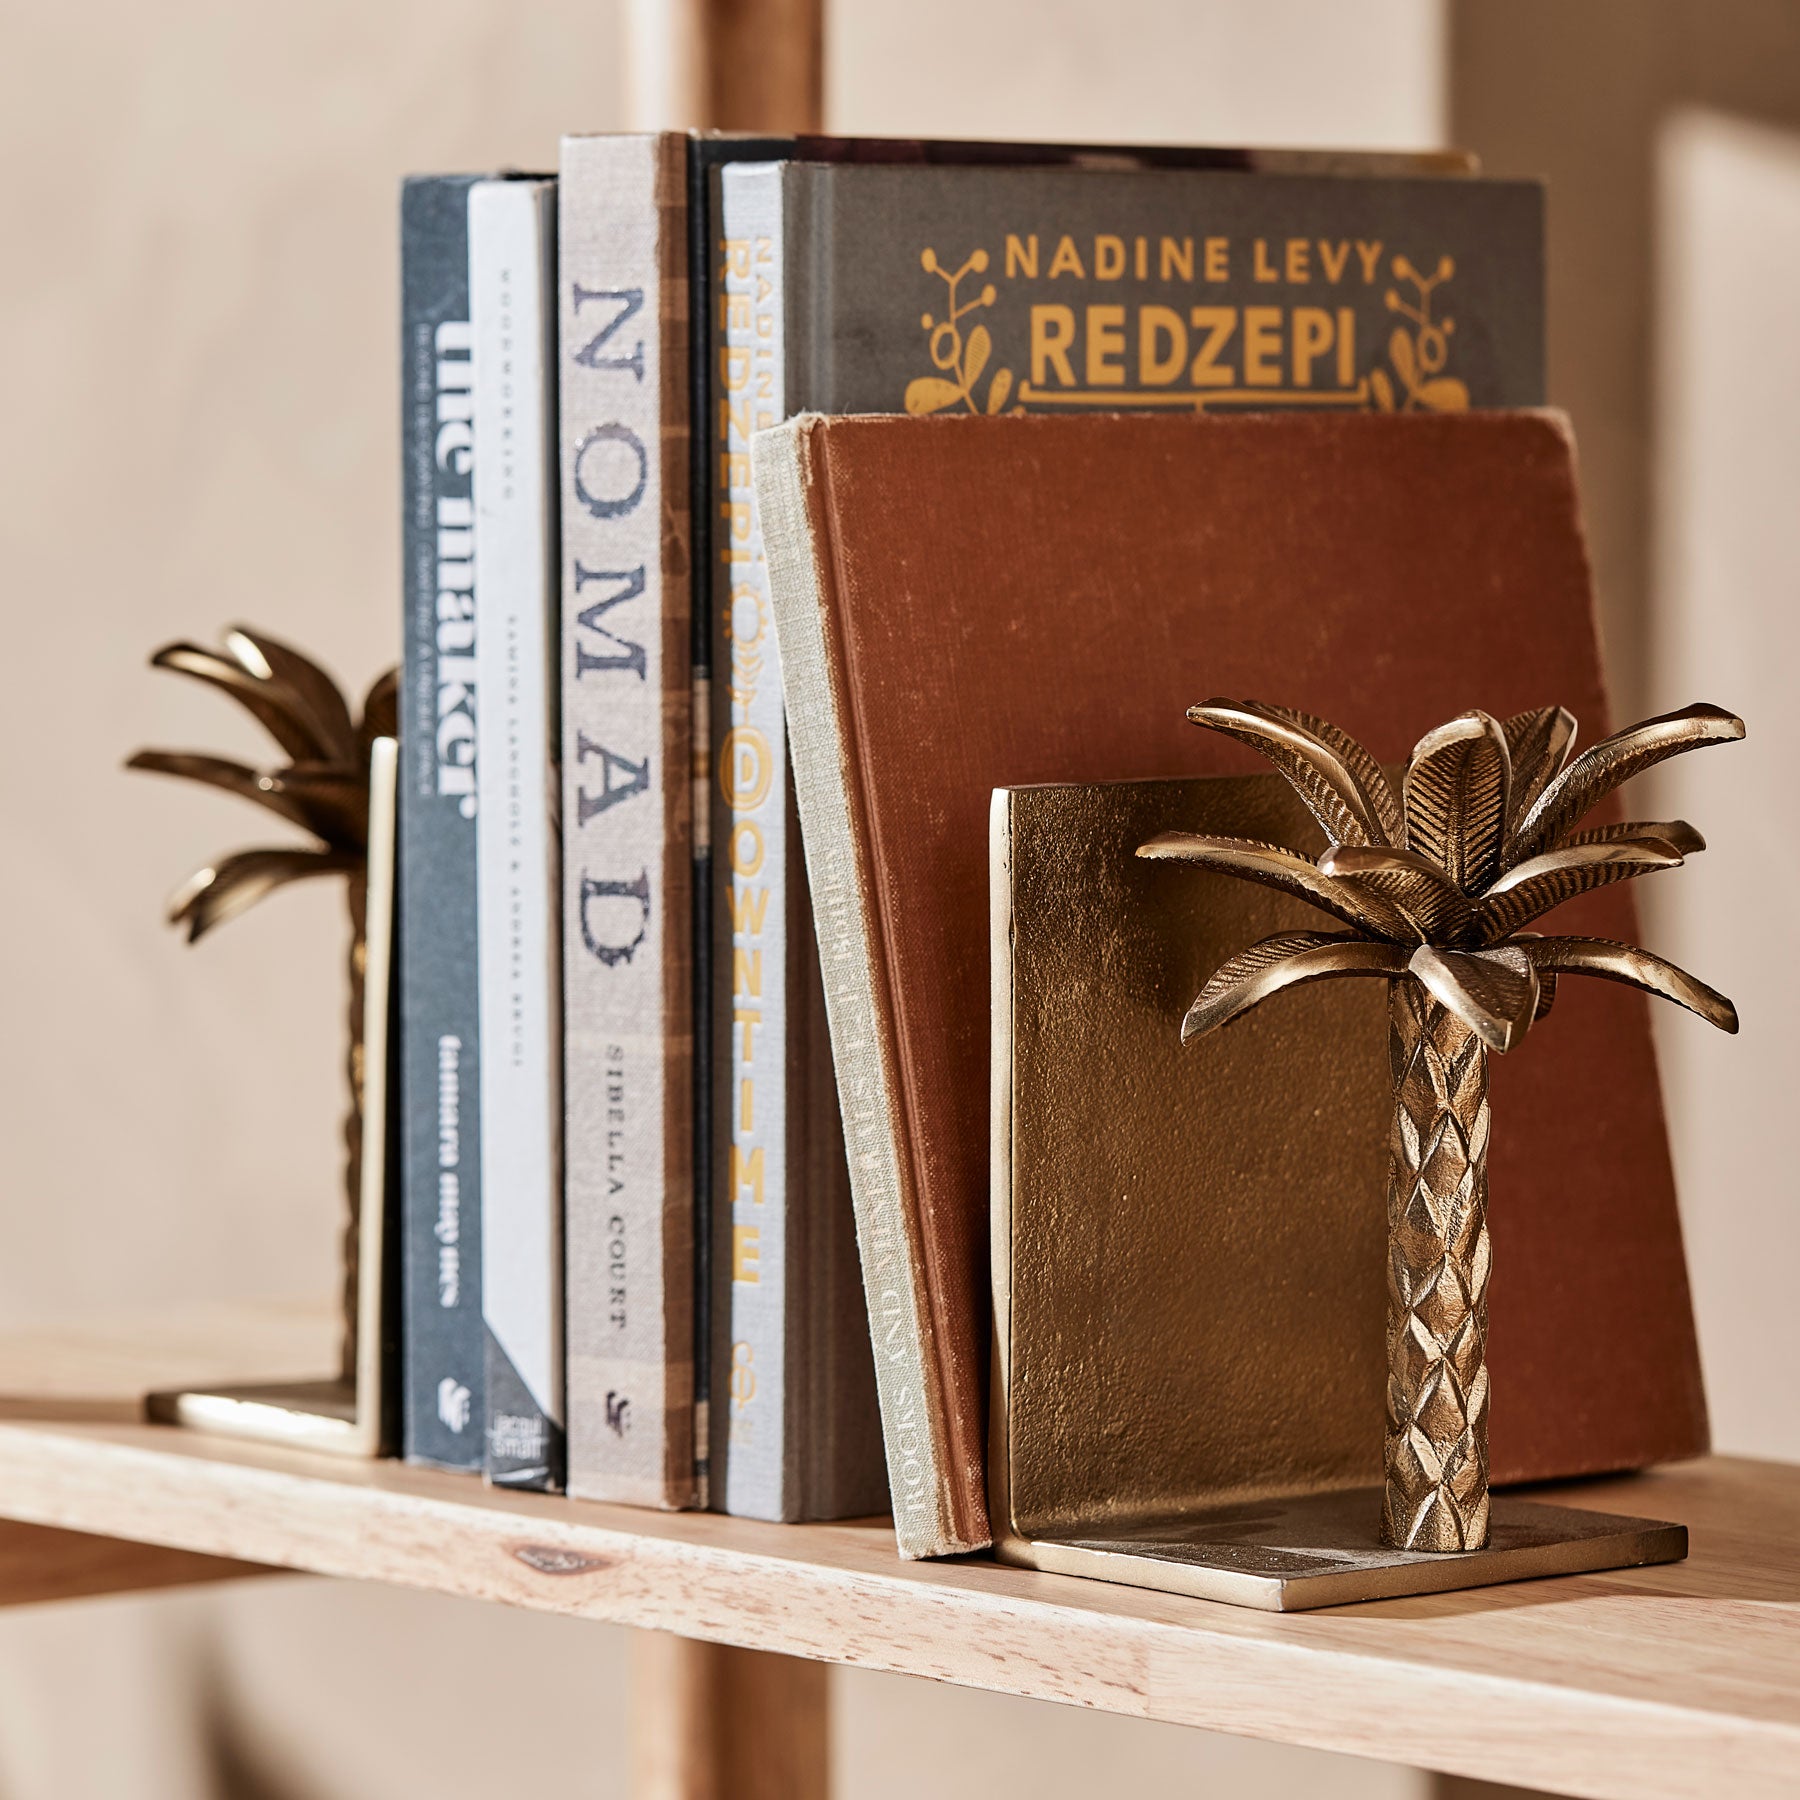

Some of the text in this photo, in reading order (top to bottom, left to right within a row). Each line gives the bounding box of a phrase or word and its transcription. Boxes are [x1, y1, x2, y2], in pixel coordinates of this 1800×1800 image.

[1005, 235, 1383, 284] NADINE LEVY
[1030, 304, 1355, 386] REDZEPI
[499, 268, 513, 500] WOODWORKING
[719, 240, 752, 563] REDZEPI
[573, 282, 648, 968] NOMAD
[438, 1035, 461, 1167] tamara
[721, 730, 771, 1283] DOWNTIME
[607, 1044, 626, 1331] SIBELLA COURT
[857, 1075, 892, 1271] MINERALS
[879, 1287, 908, 1369] AND
[894, 1386, 926, 1513] ROCKS
